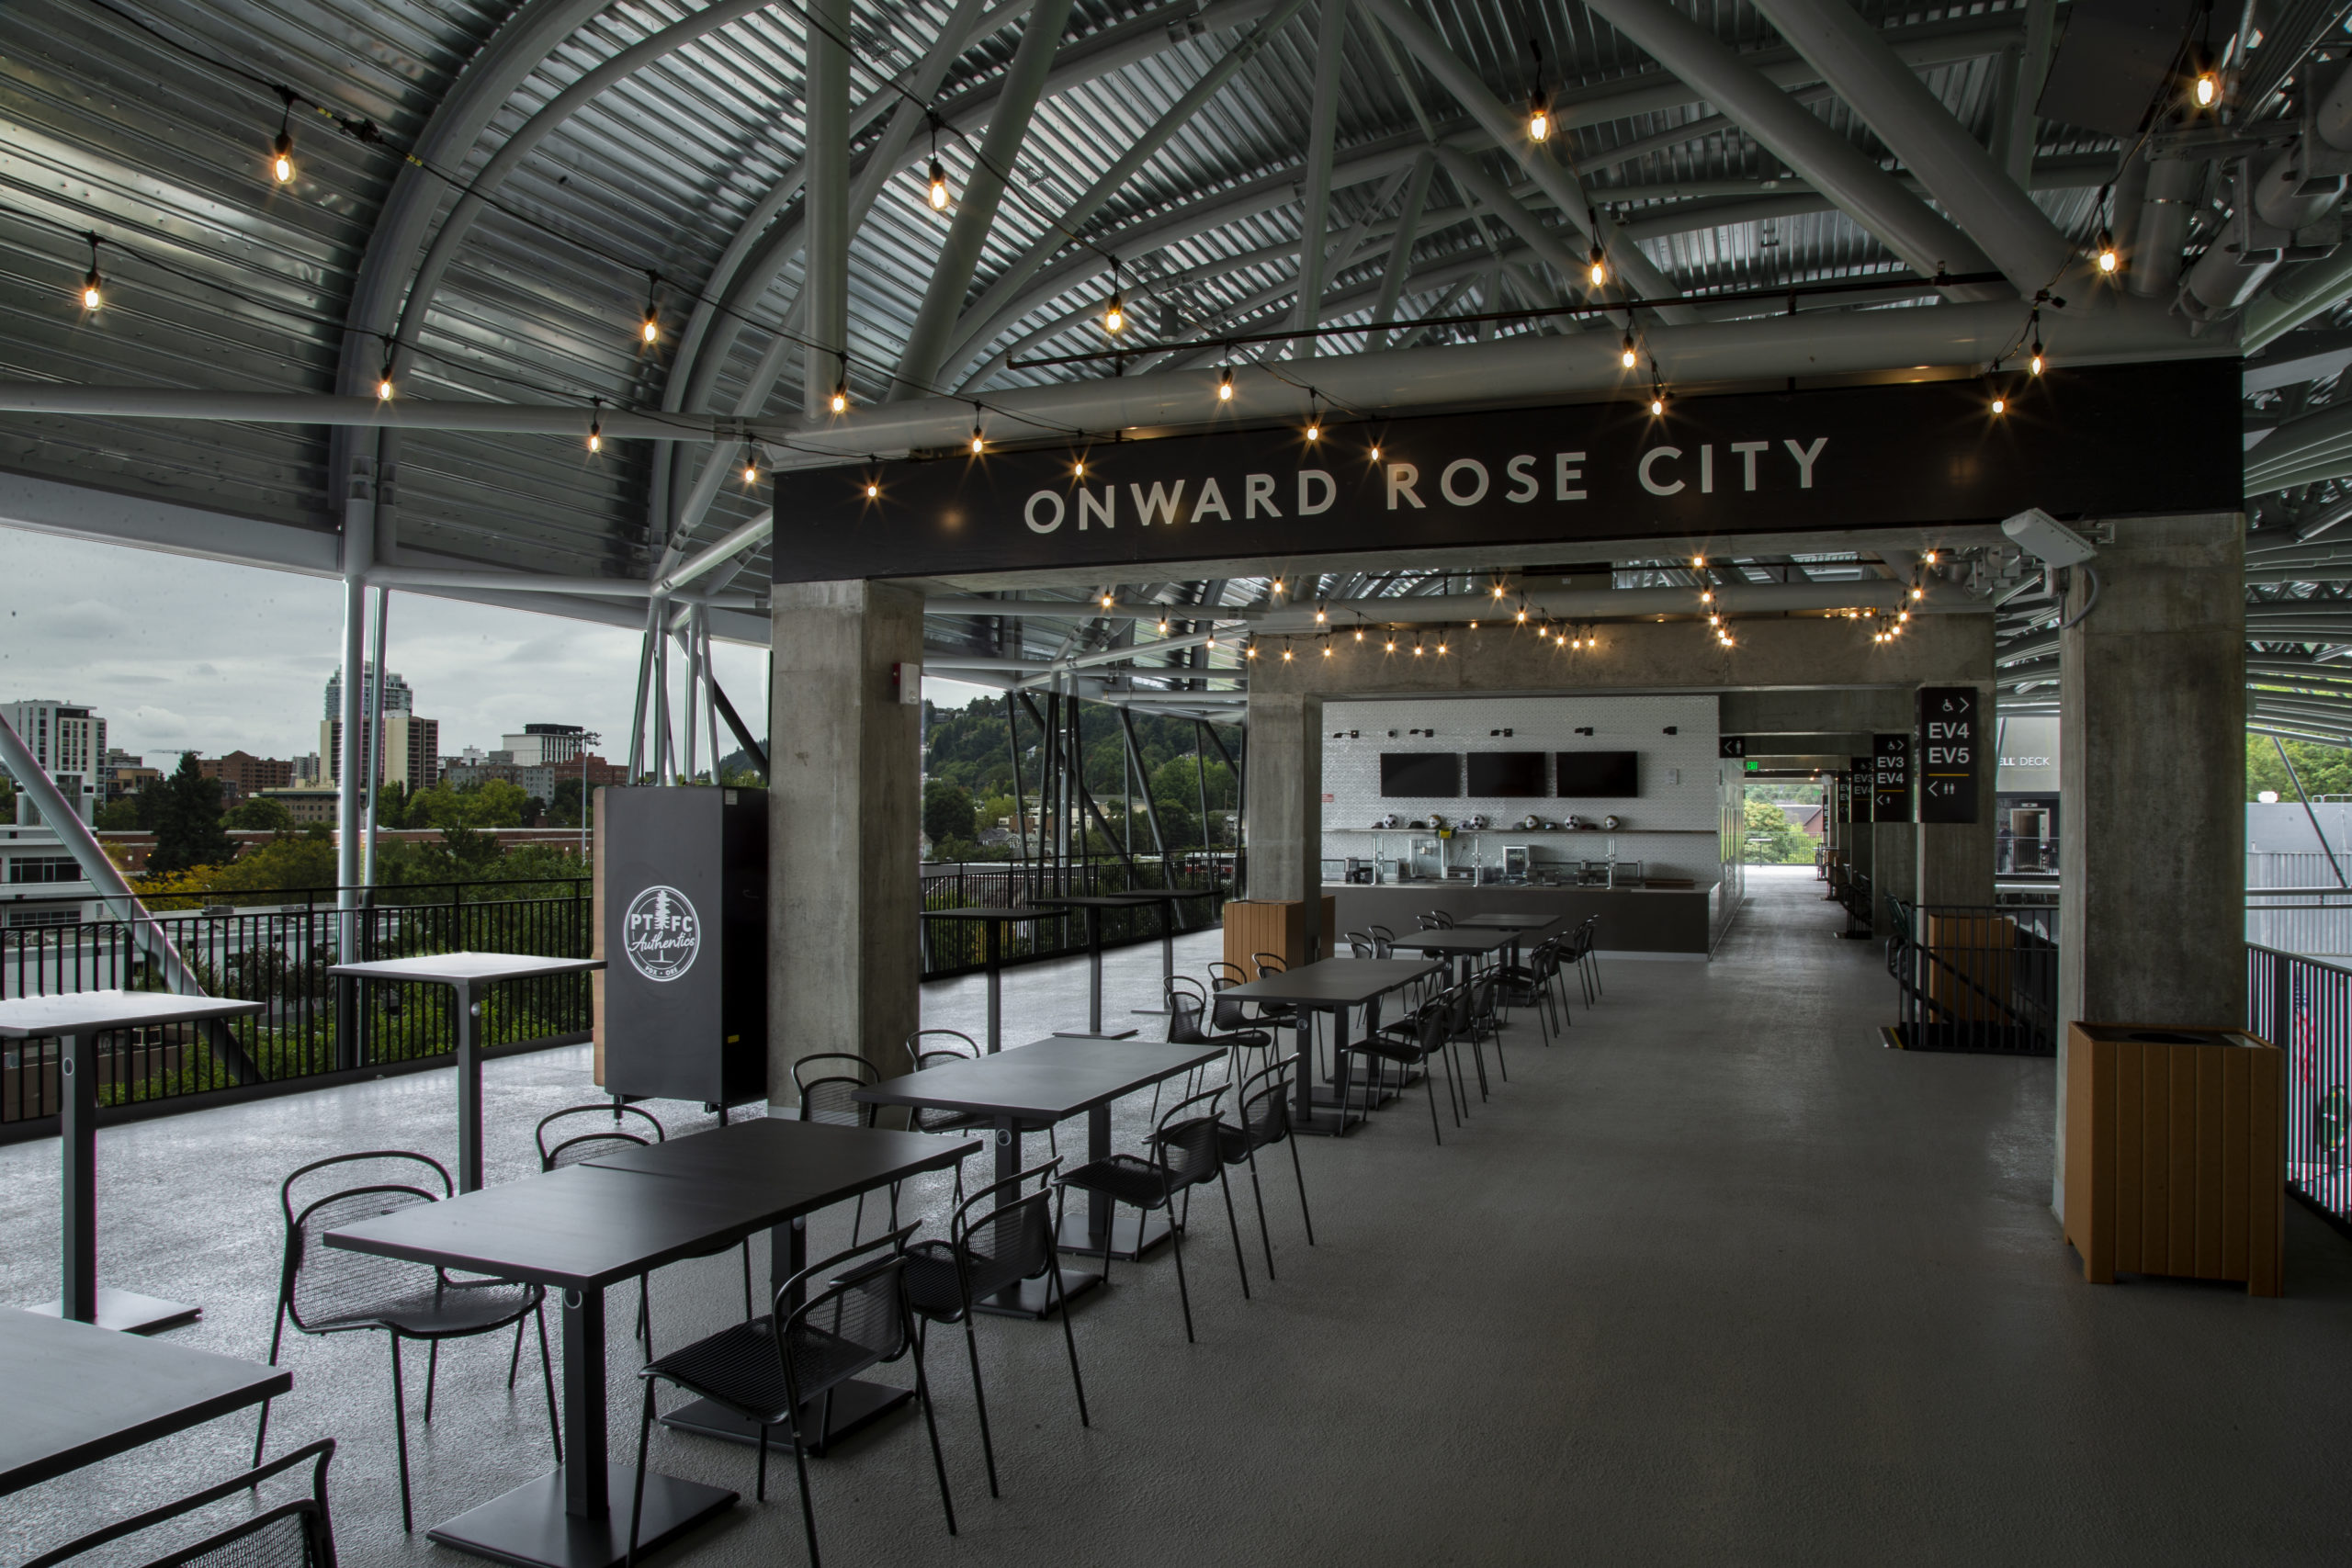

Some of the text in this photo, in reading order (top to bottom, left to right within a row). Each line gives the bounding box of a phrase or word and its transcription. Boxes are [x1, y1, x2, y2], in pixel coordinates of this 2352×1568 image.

[1023, 436, 1830, 535] ONWARD ROSE CITY
[1928, 722, 1970, 739] EV4
[1876, 756, 1905, 768] EV3
[1928, 747, 1970, 764] EV5
[2019, 757, 2051, 766] DECK
[1876, 773, 1905, 784] EV4
[628, 931, 695, 952] Authentics
[645, 965, 658, 976] PDX
